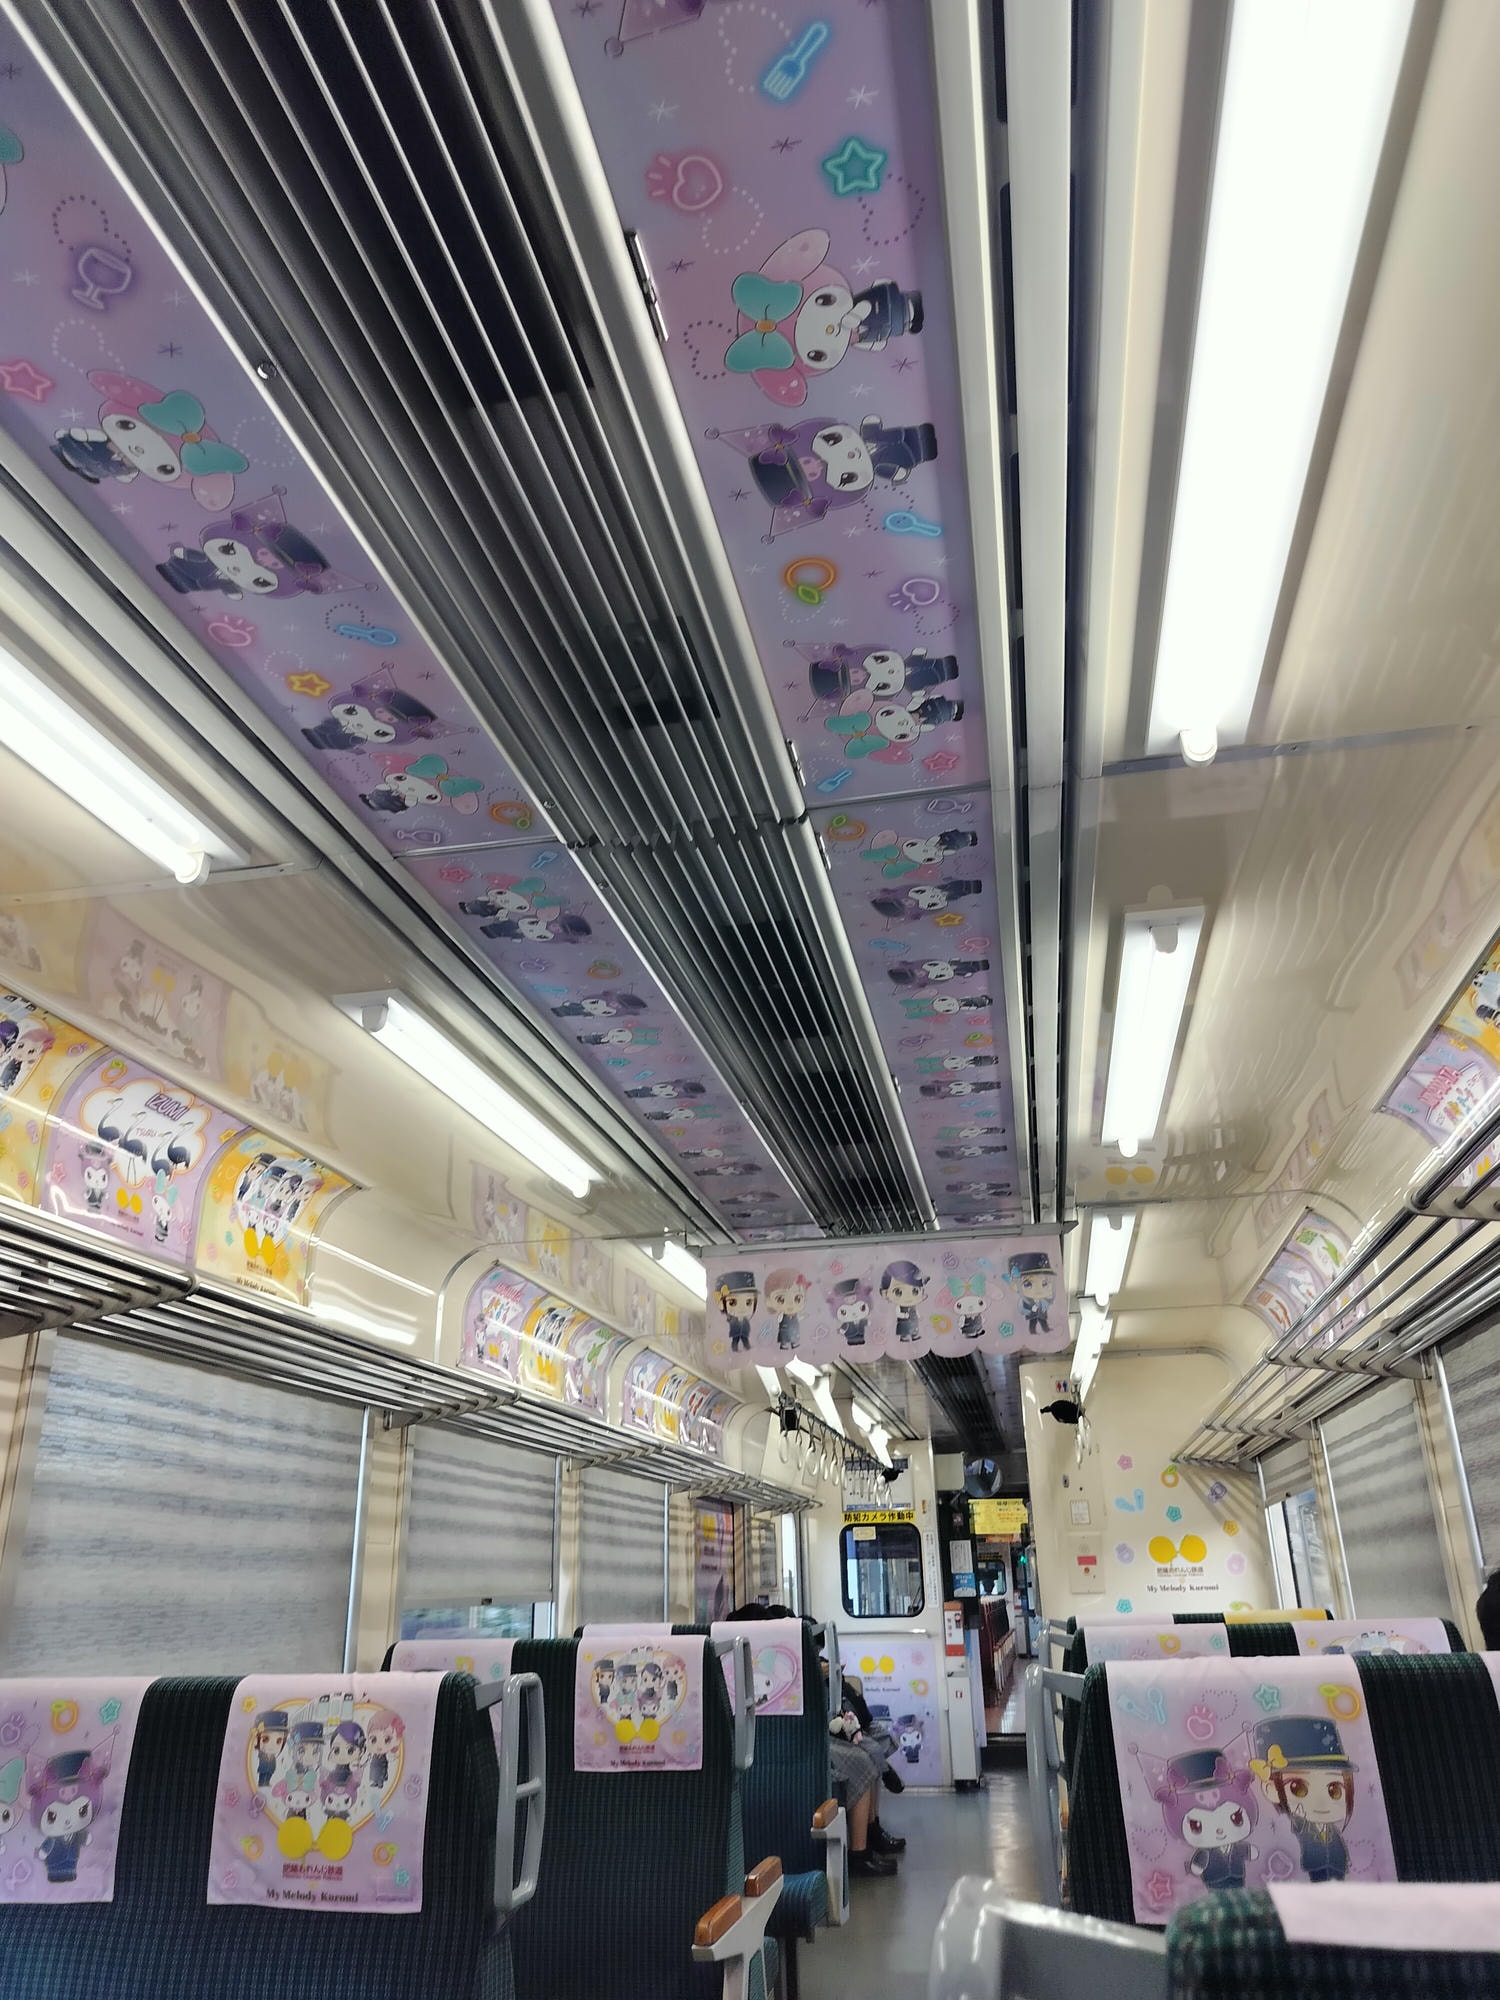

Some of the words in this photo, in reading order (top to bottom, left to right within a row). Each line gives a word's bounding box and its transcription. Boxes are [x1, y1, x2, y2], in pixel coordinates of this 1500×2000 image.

[144, 1092, 190, 1122] IZUMI
[844, 1511, 914, 1522] 防犯カメラ作動中
[1160, 1584, 1187, 1593] Melody
[266, 1888, 281, 1901] My
[282, 1889, 317, 1903] Melody
[320, 1890, 359, 1903] Kuromi
